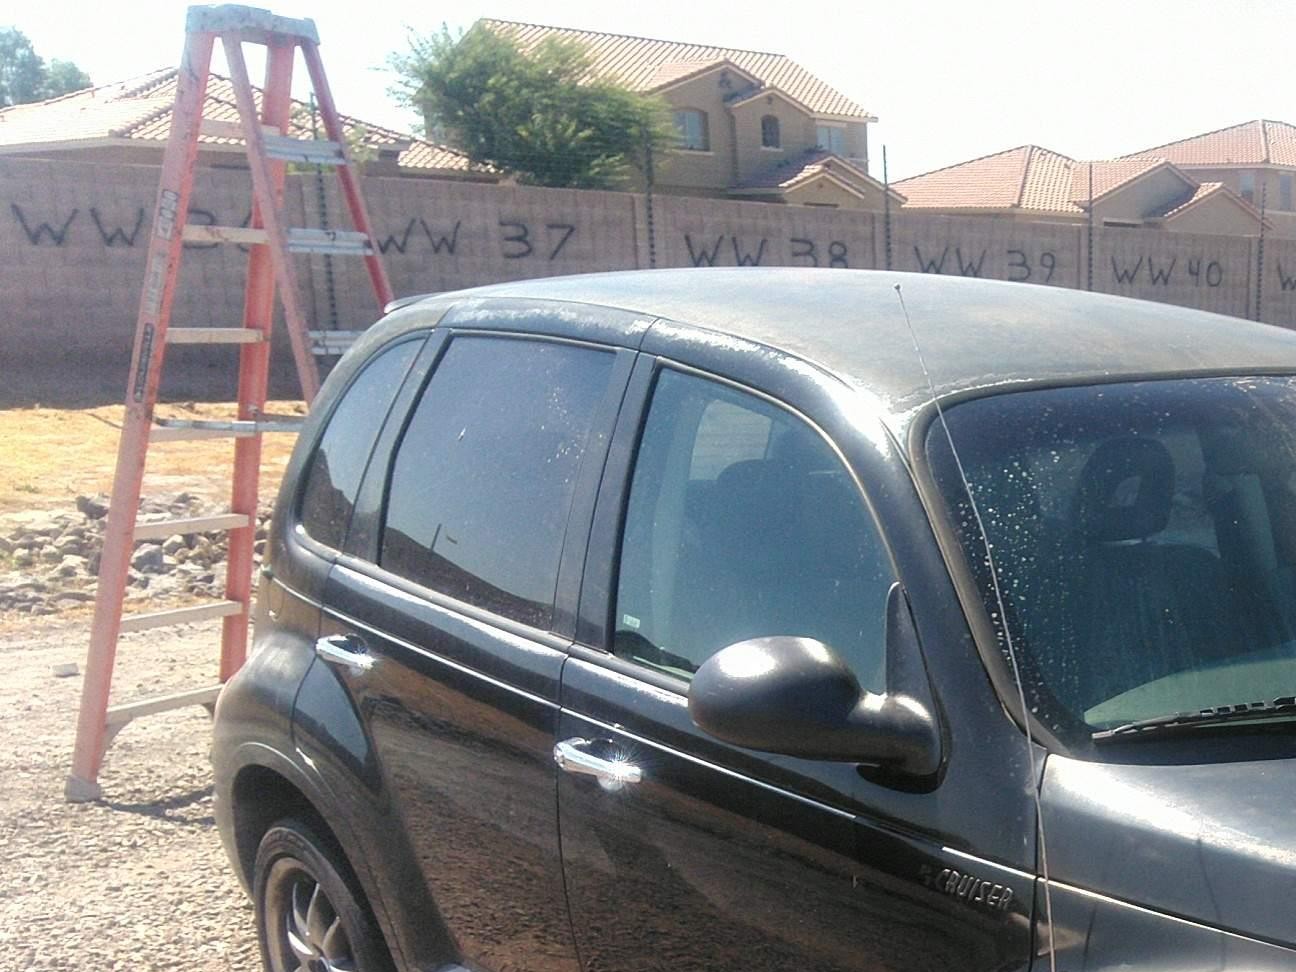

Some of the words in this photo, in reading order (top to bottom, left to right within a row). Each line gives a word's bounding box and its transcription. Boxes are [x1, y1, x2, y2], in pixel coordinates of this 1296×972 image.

[377, 217, 461, 254] WW
[499, 220, 576, 260] 37
[684, 234, 769, 267] WW
[789, 238, 849, 268] 38
[913, 244, 987, 277] WW
[1007, 249, 1056, 282] 39
[1111, 255, 1177, 286] WW
[1187, 259, 1223, 287] 40
[935, 868, 1014, 911] CRUISER
